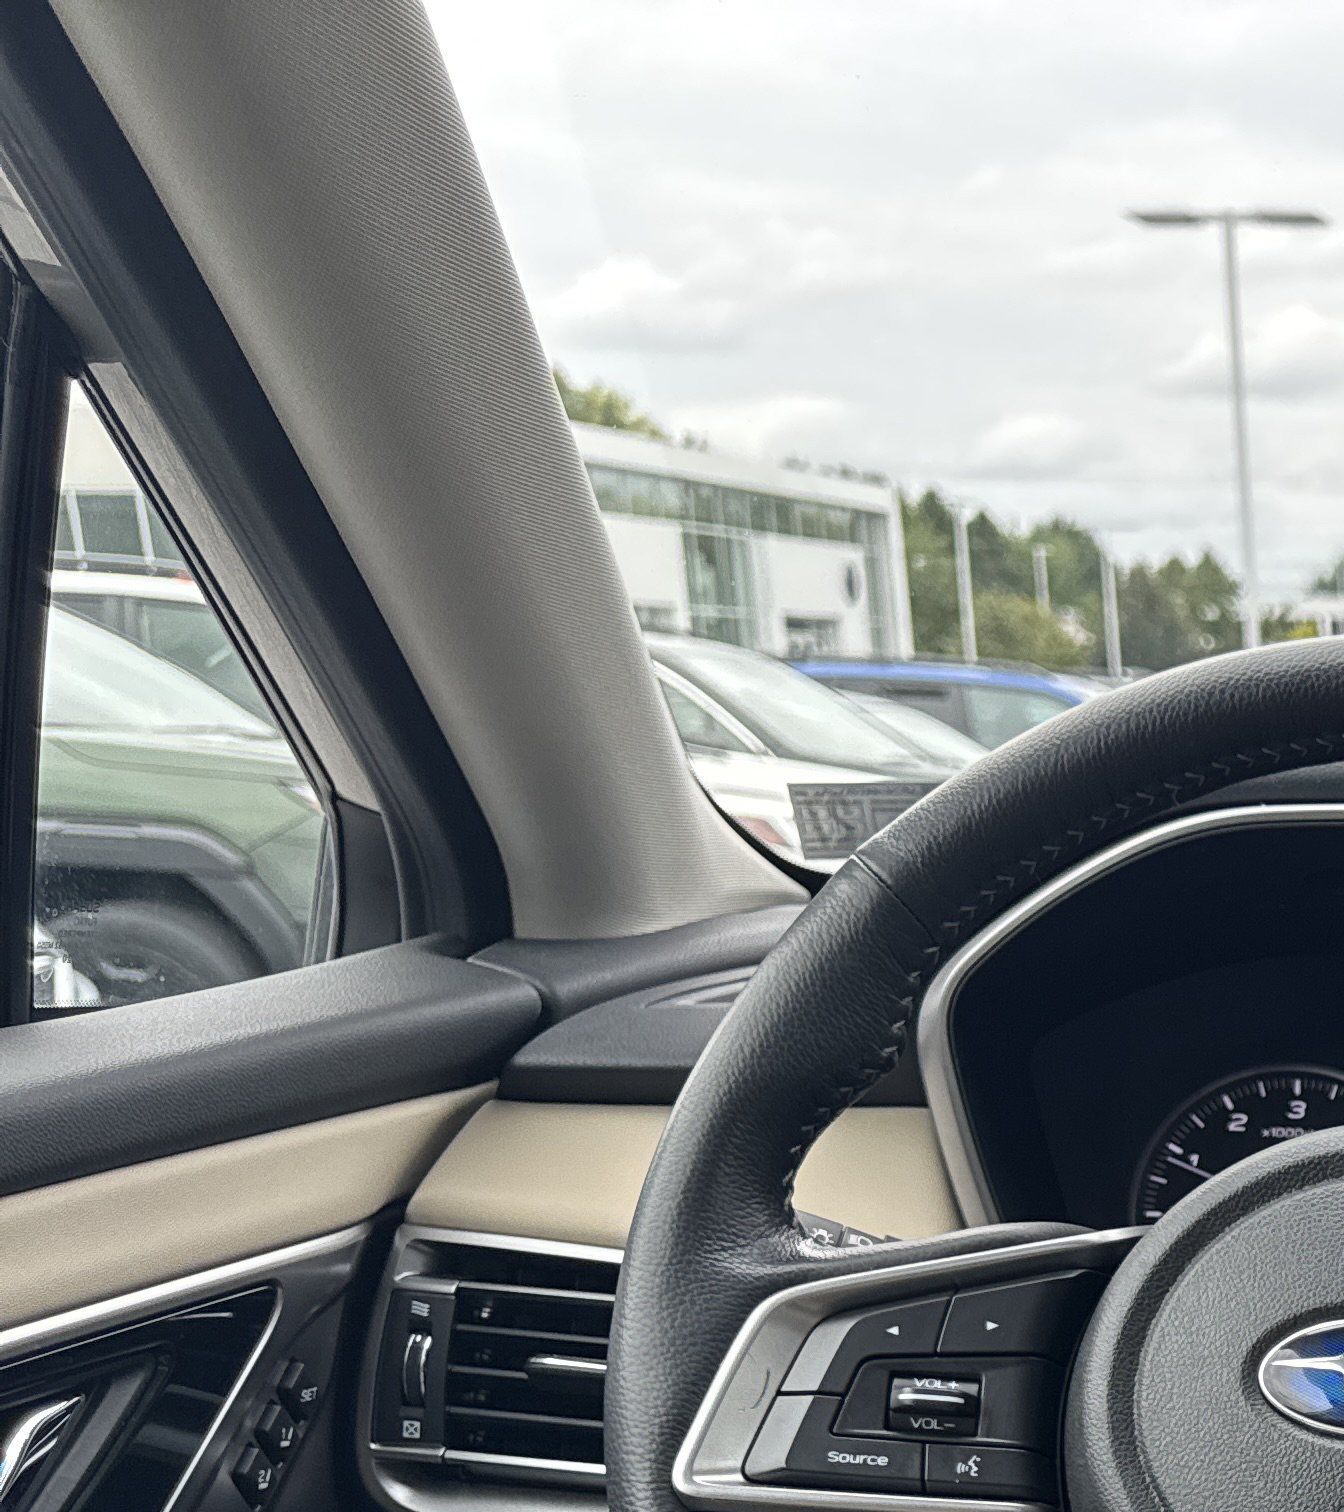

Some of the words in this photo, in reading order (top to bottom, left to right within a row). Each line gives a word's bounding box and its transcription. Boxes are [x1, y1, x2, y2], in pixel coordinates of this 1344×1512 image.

[1285, 1100, 1307, 1119] 3
[1227, 1113, 1249, 1132] 2
[827, 1450, 889, 1467] Source
